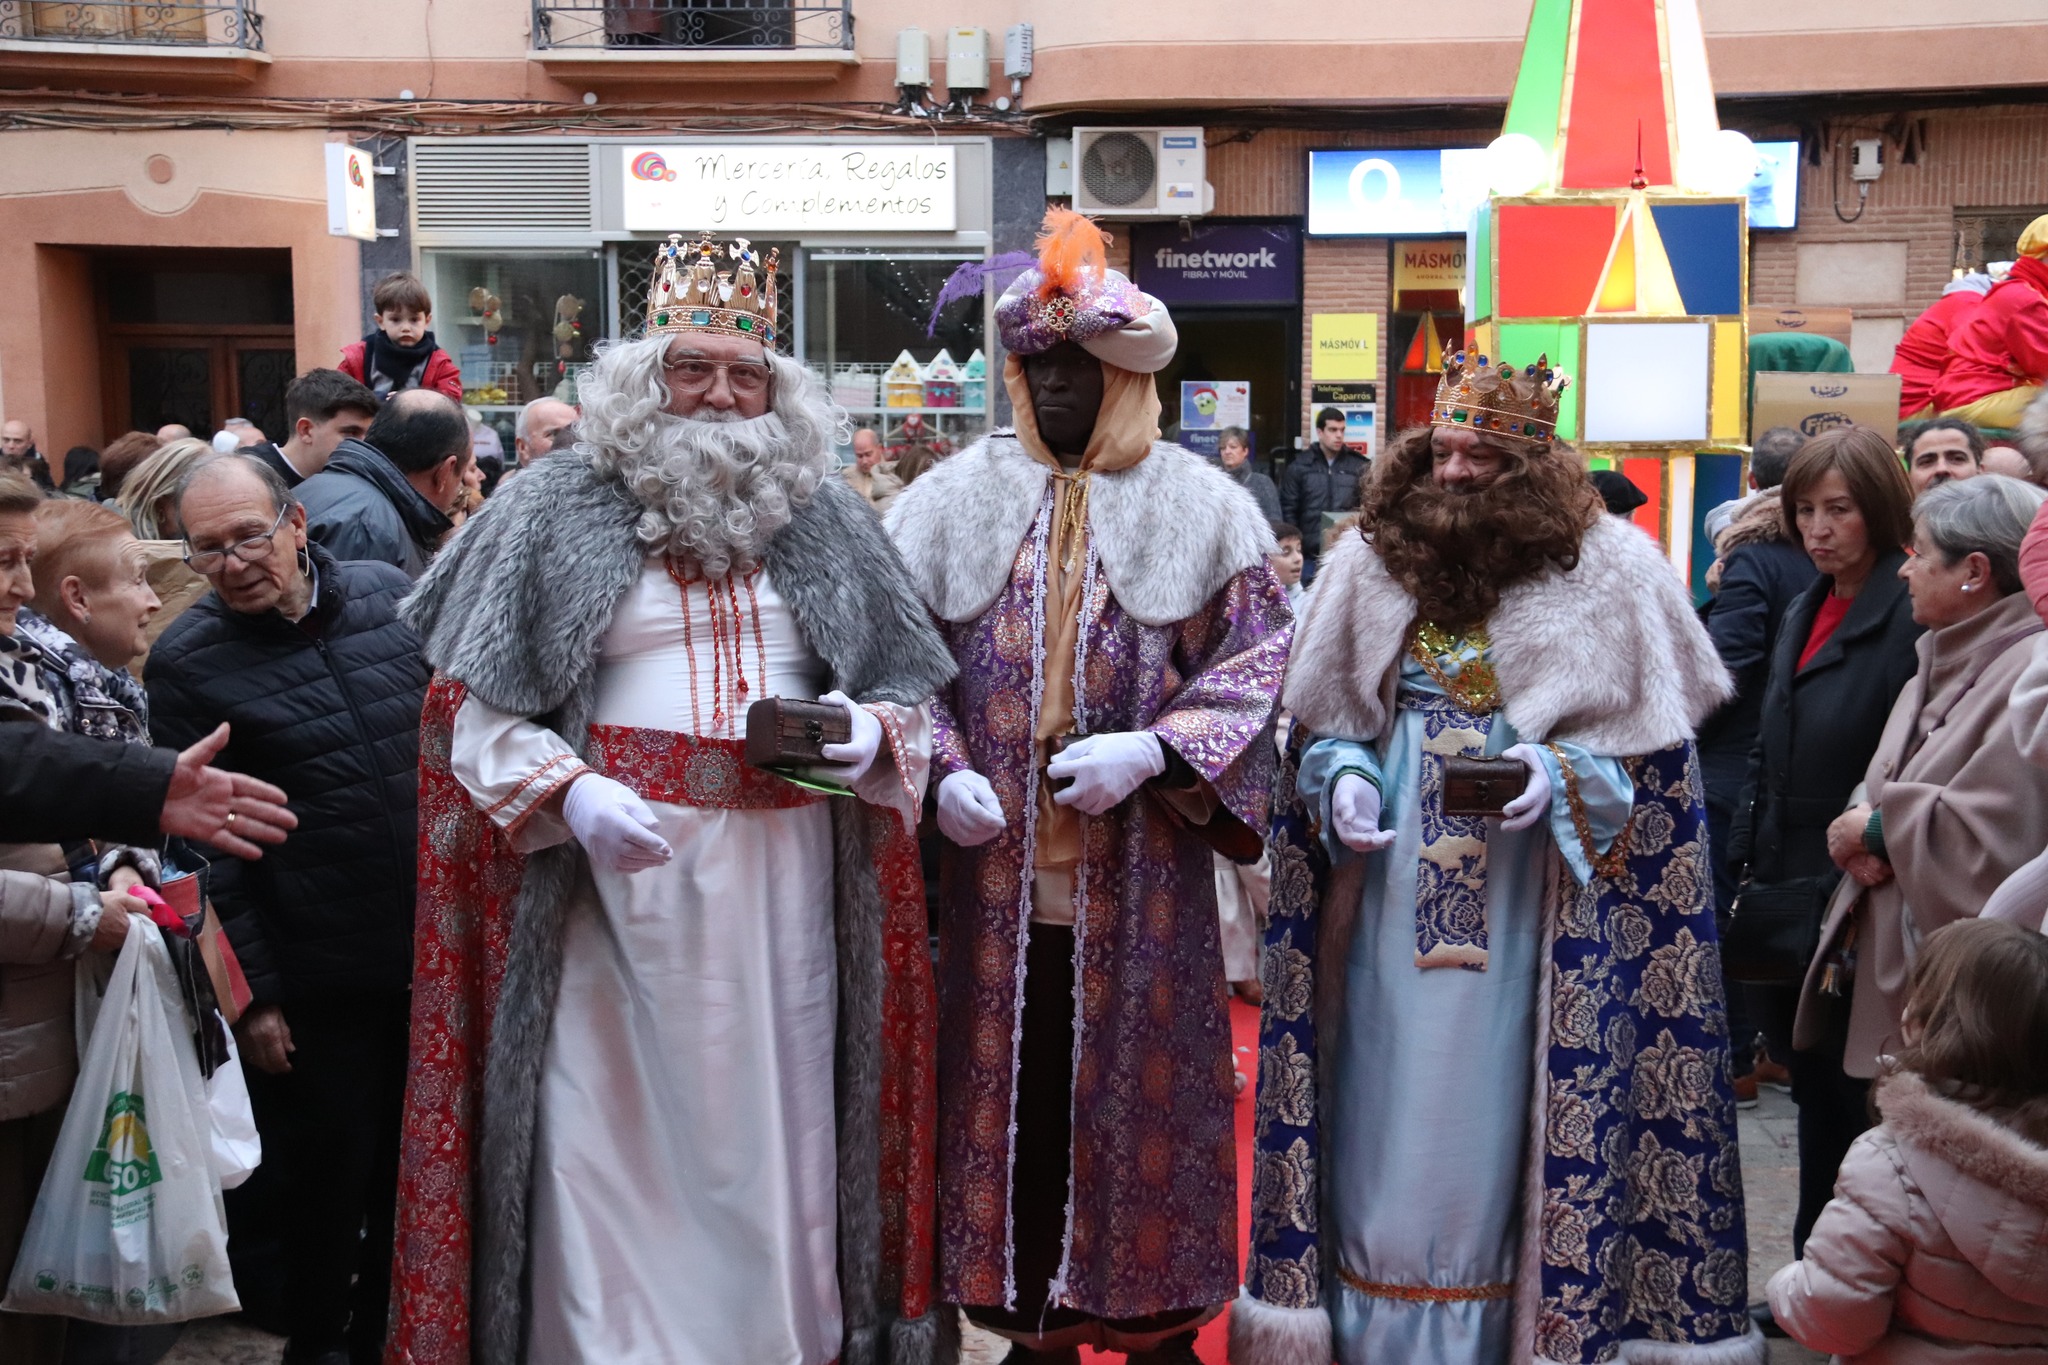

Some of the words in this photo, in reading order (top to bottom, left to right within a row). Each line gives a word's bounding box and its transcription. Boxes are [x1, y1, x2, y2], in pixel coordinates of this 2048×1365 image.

[841, 151, 948, 191] Regalos
[711, 194, 728, 223] y
[741, 190, 932, 224] Complementos
[1155, 247, 1277, 268] finetwork
[1183, 270, 1210, 279] FIBRA
[1210, 270, 1217, 279] Y
[1219, 269, 1248, 279] MÓVIL
[1332, 392, 1371, 401] Caparrós
[1190, 433, 1219, 443] finet
